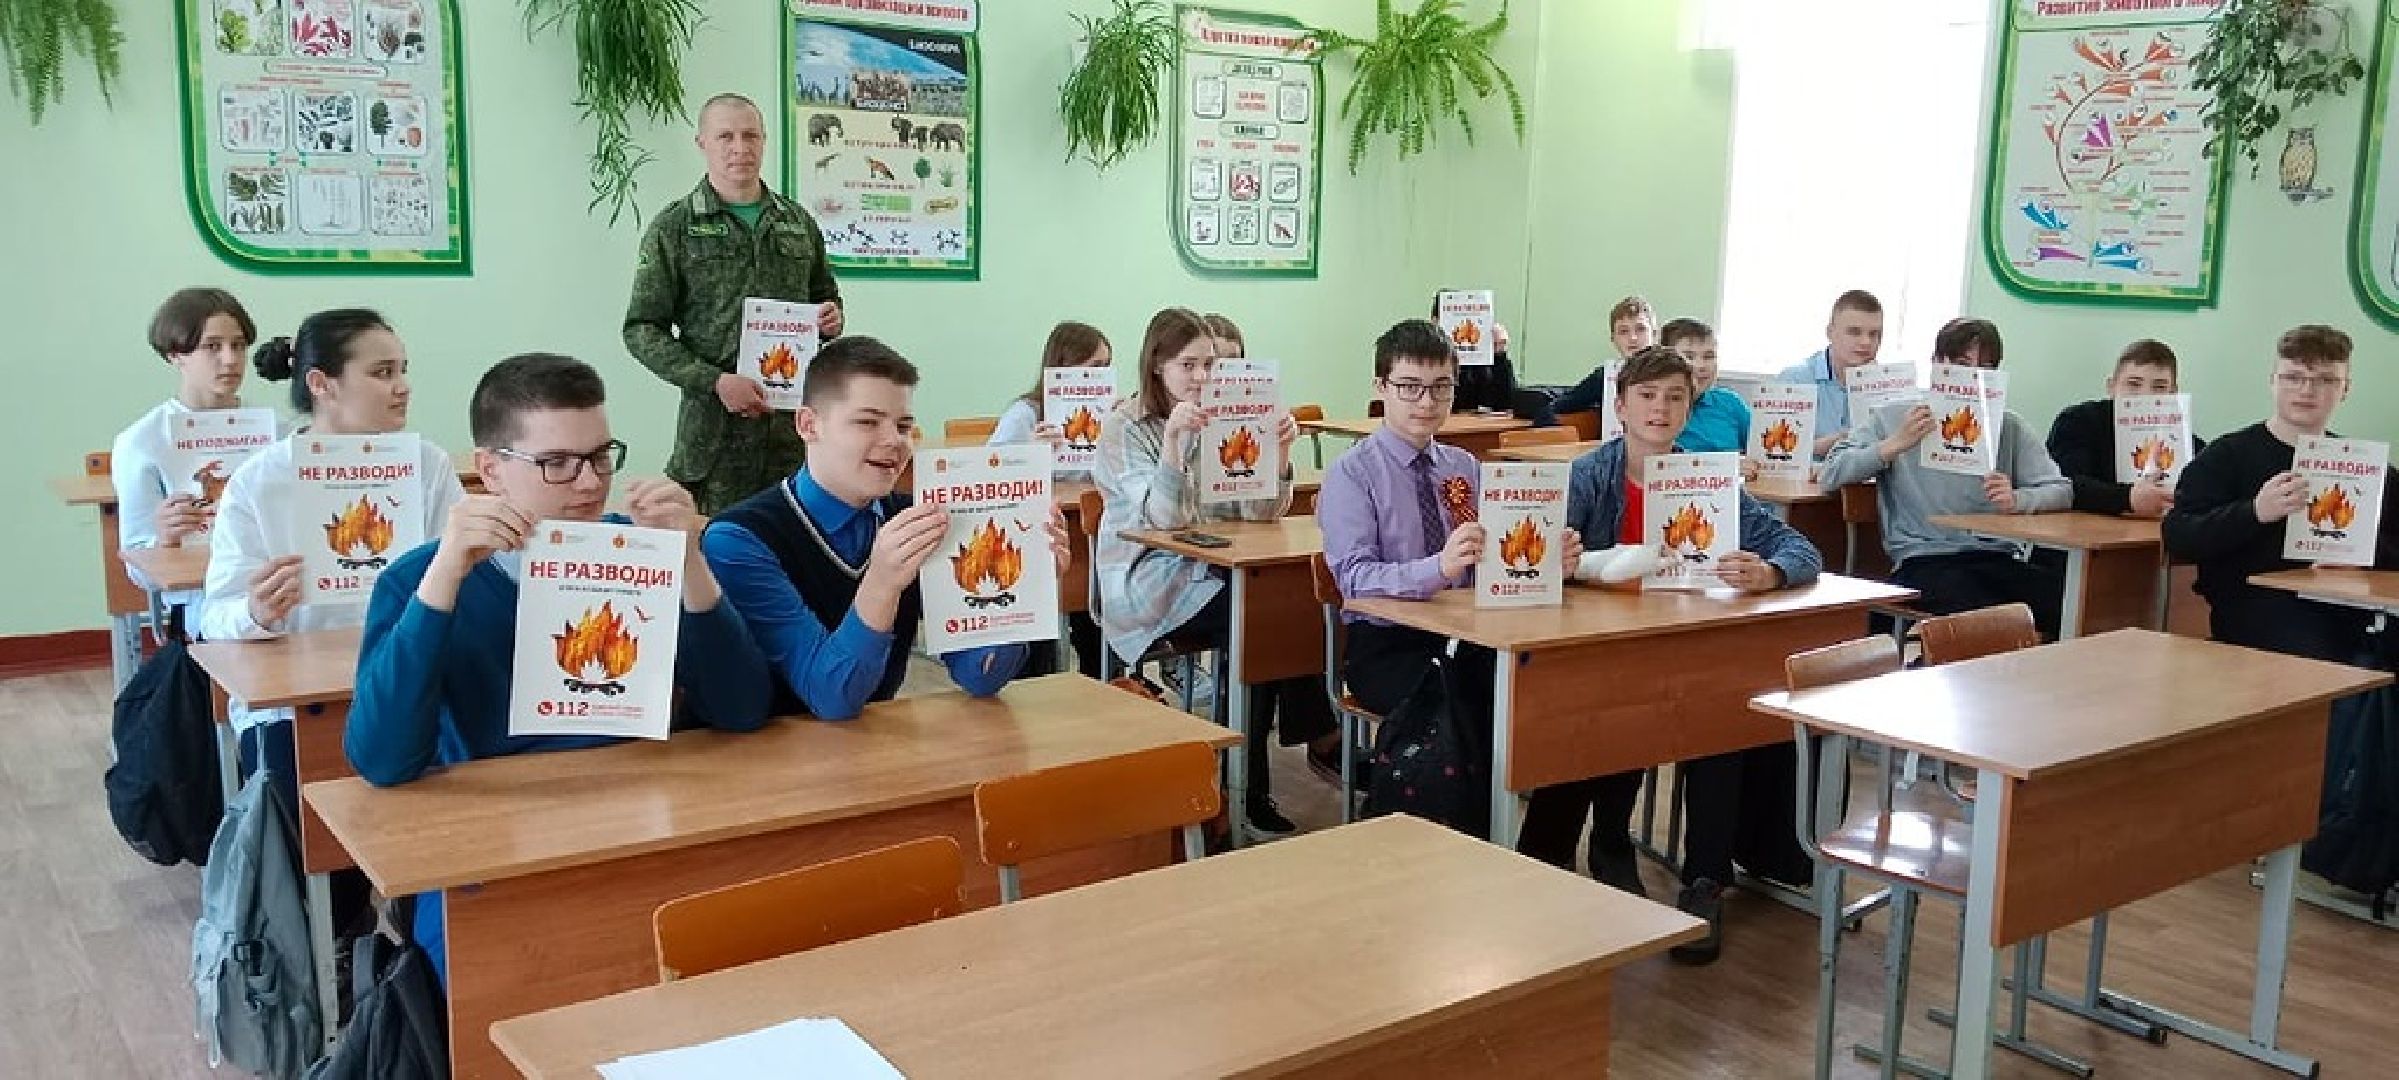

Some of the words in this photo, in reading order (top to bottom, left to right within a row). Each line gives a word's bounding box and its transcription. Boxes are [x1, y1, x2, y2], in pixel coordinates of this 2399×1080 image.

[299, 466, 321, 481] НЕ
[325, 463, 415, 481] РАЗВОДИ!
[923, 488, 947, 504] НЕ
[951, 480, 1043, 502] РАЗВОДИ!
[530, 561, 559, 579] НЕ
[563, 561, 674, 588] РАЗВОДИ!
[961, 615, 990, 633] 112
[557, 701, 590, 717] 112
